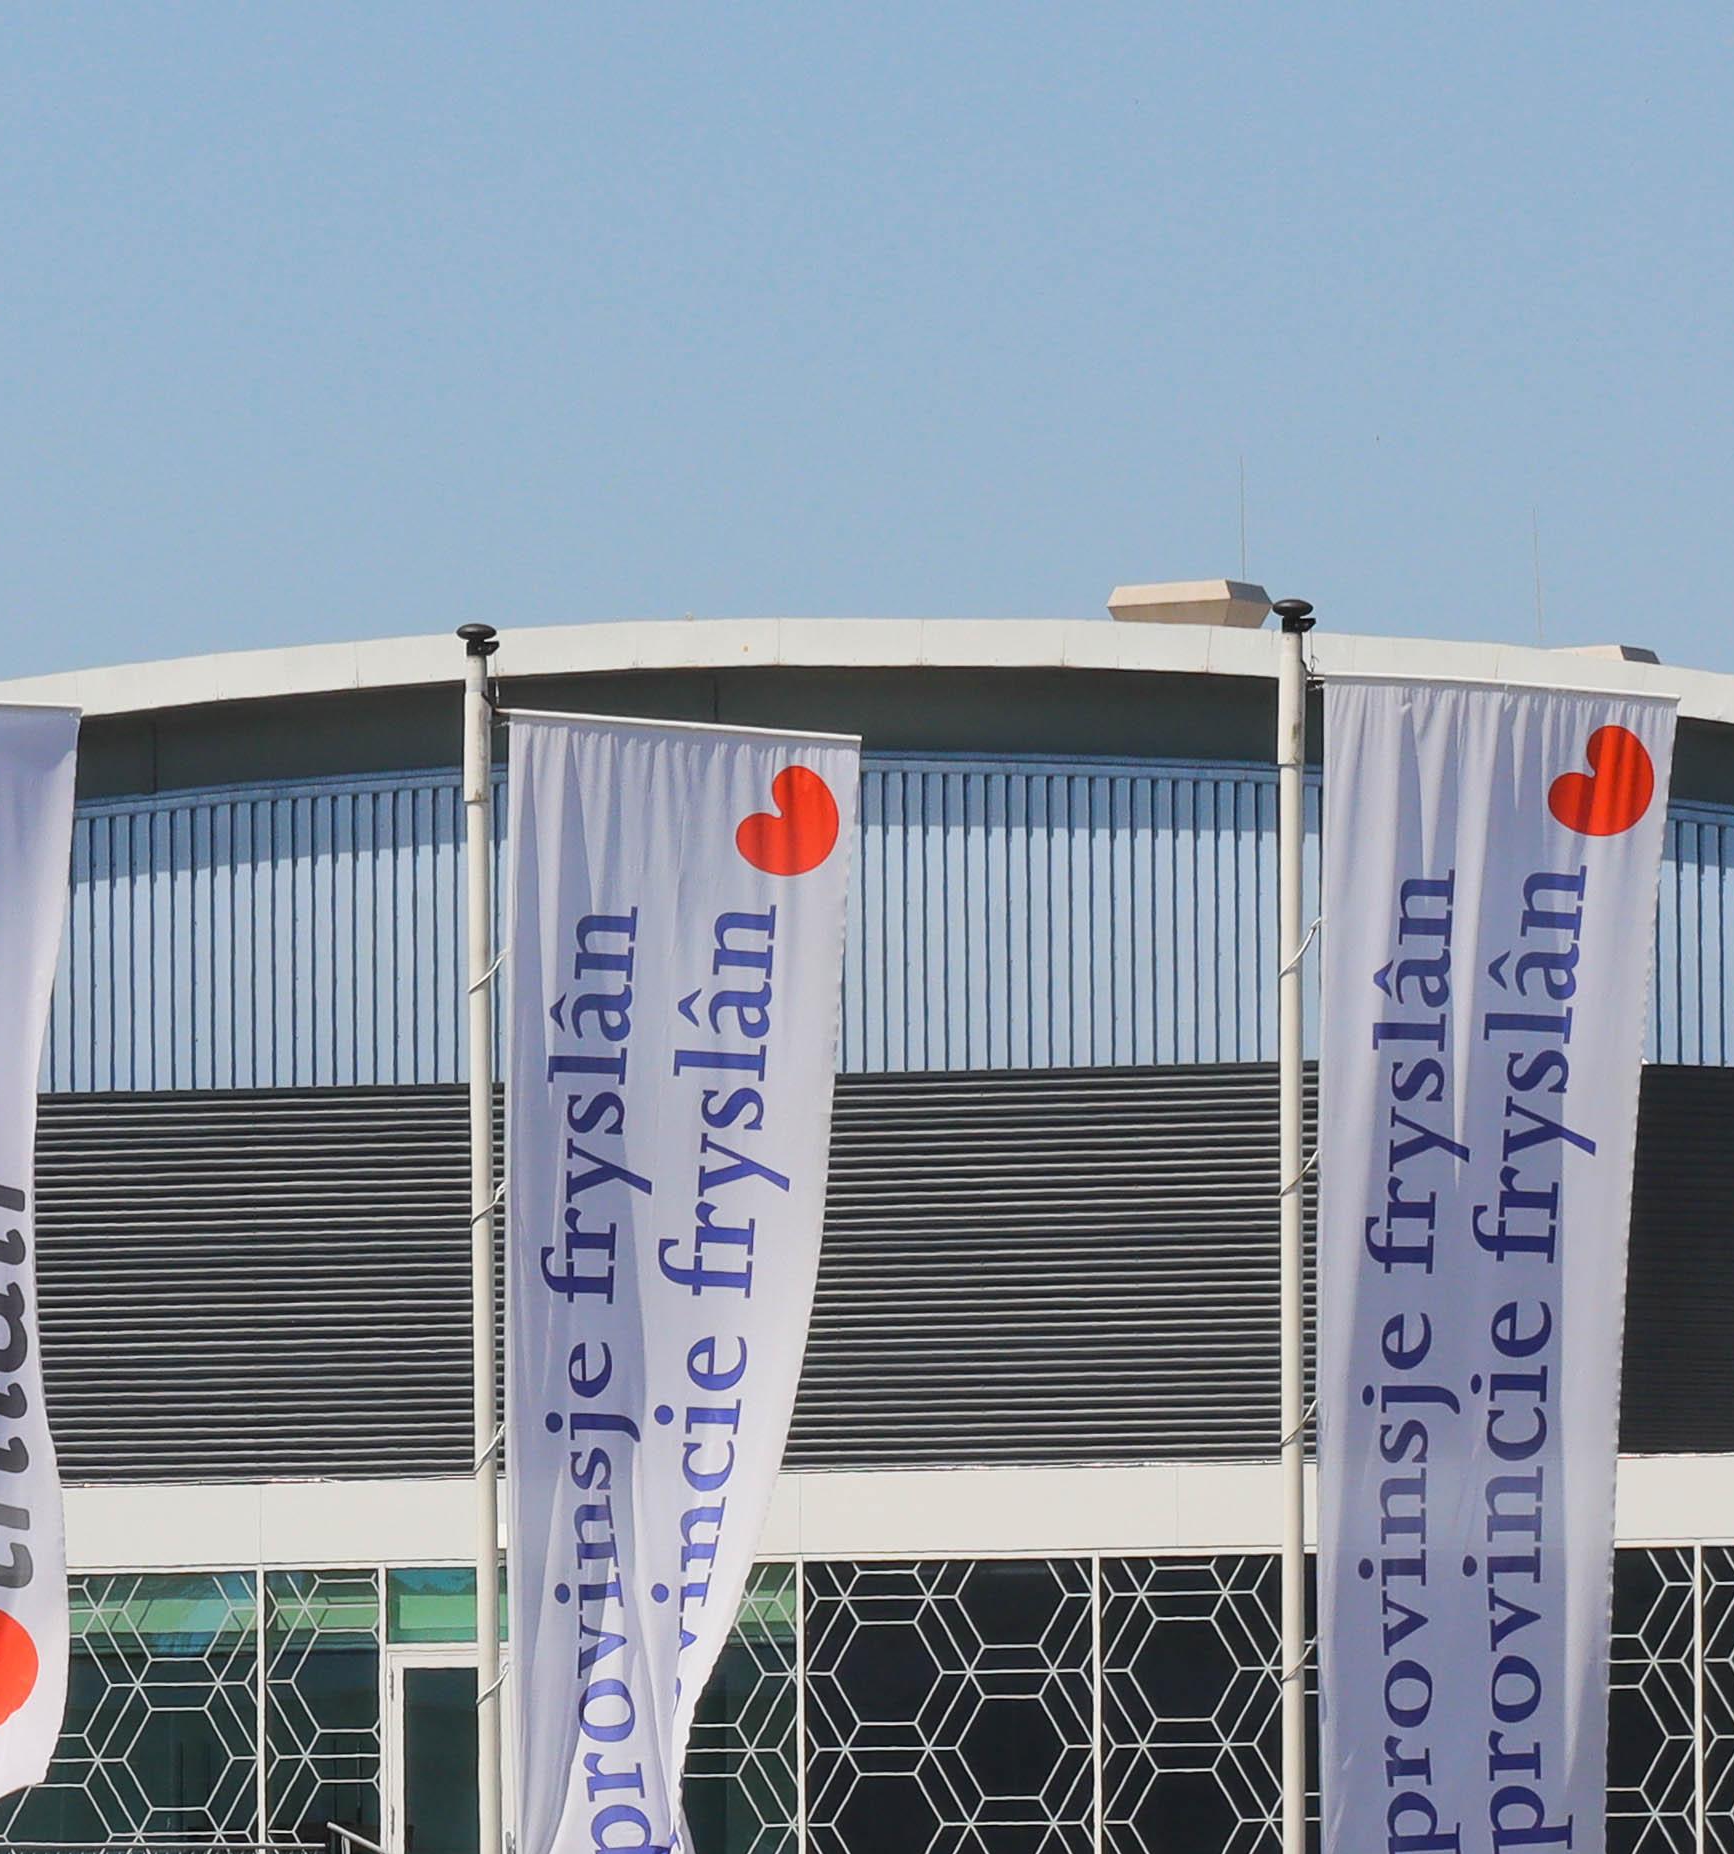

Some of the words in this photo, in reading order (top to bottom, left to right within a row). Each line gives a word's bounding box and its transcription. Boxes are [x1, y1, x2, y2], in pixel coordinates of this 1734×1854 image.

[541, 906, 652, 1304] fryslân
[658, 905, 790, 1299] fryslân
[1365, 868, 1470, 1275] fryslân
[1472, 864, 1596, 1264] fryslân
